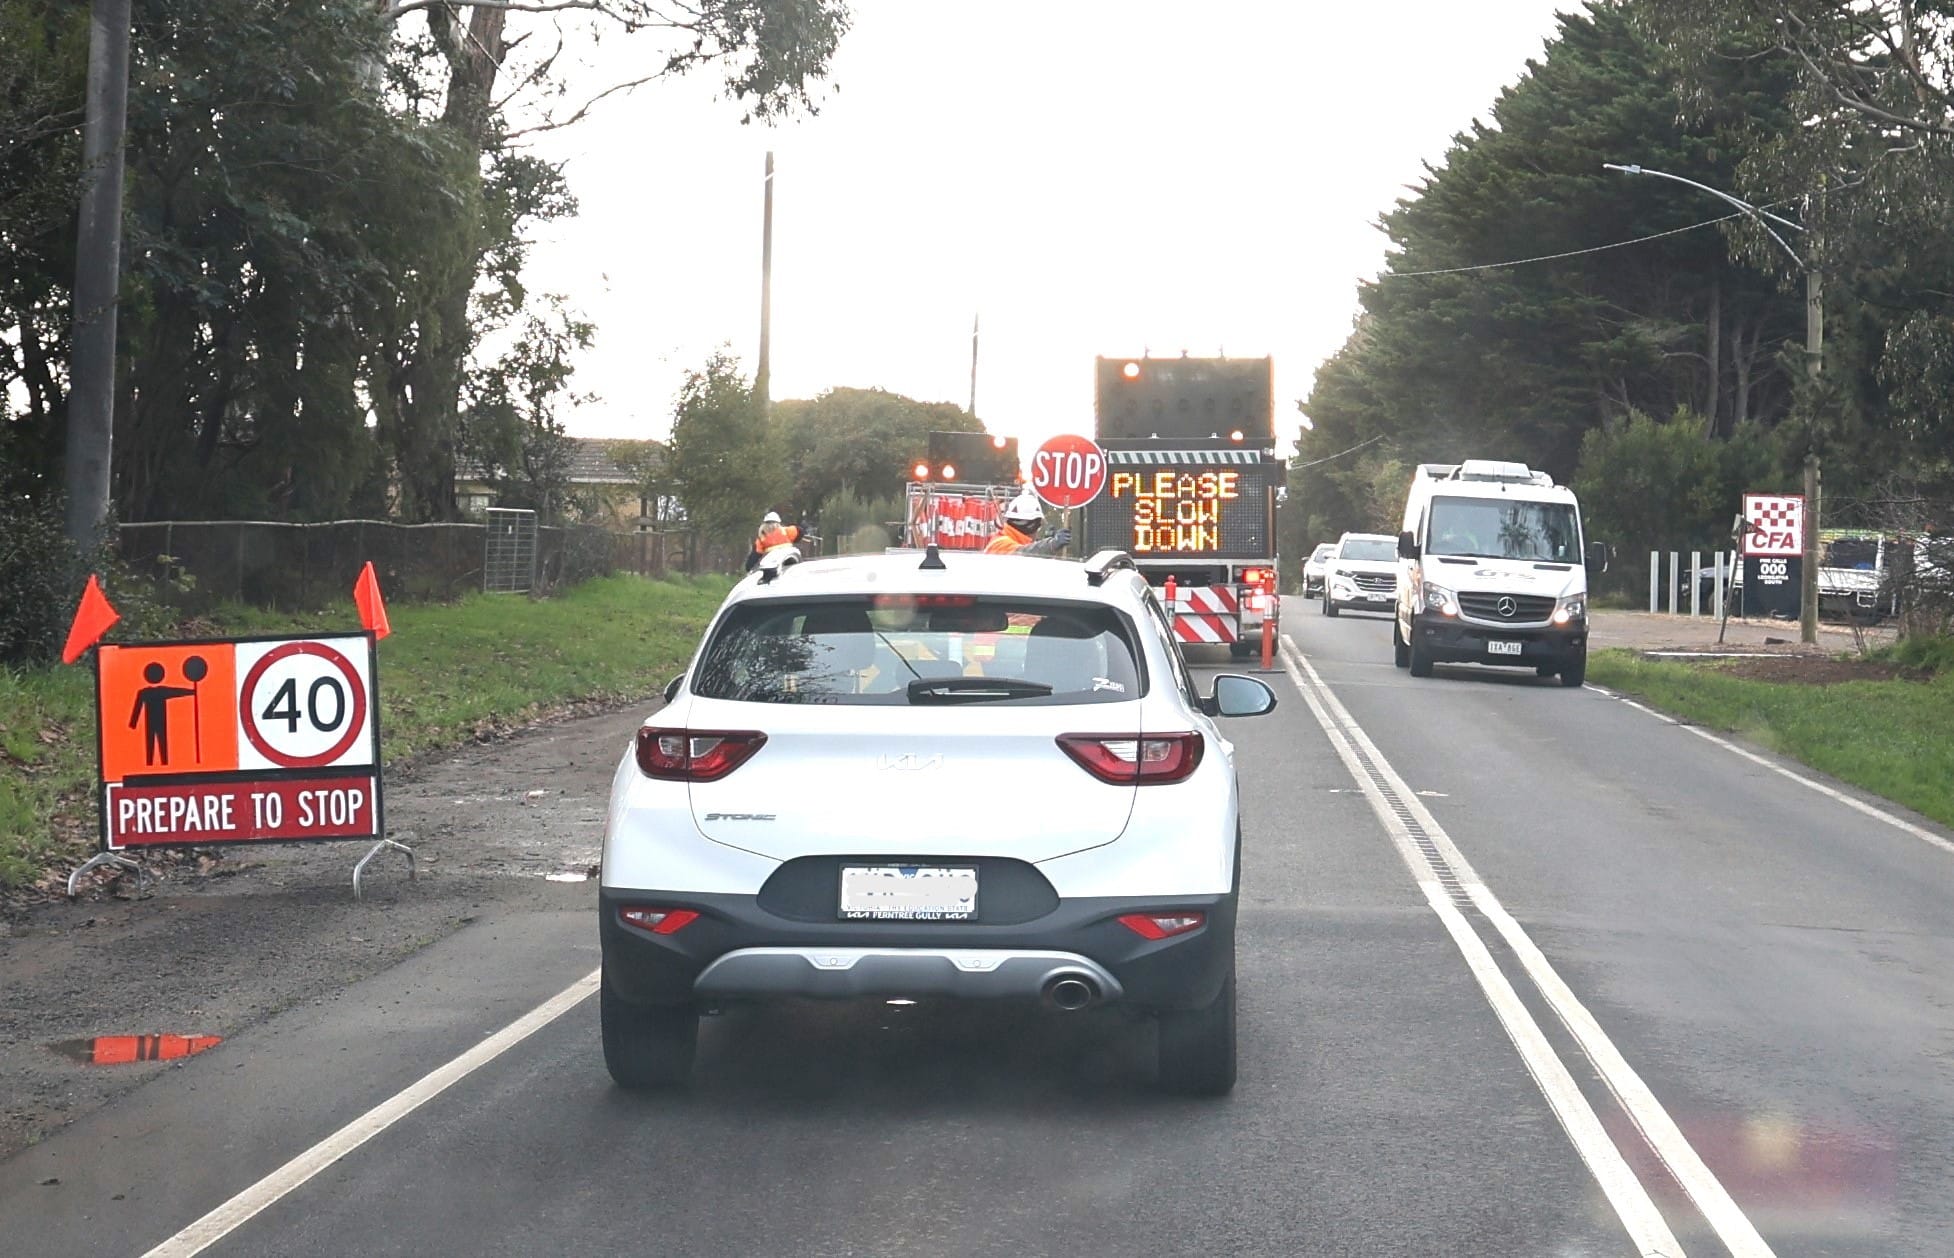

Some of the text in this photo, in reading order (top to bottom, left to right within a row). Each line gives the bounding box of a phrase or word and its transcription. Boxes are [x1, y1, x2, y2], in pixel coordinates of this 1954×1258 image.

[1035, 451, 1101, 489] STOP
[1112, 472, 1239, 498] PLEASE
[1134, 499, 1218, 524] SLOW
[1134, 525, 1218, 550] DOWN
[1752, 531, 1795, 549] CFA
[1760, 563, 1787, 575] 000
[262, 676, 345, 733] 40
[119, 789, 364, 834] PREPARE TO STOP
[704, 813, 776, 821] STONIC
[915, 911, 941, 919] GULLY
